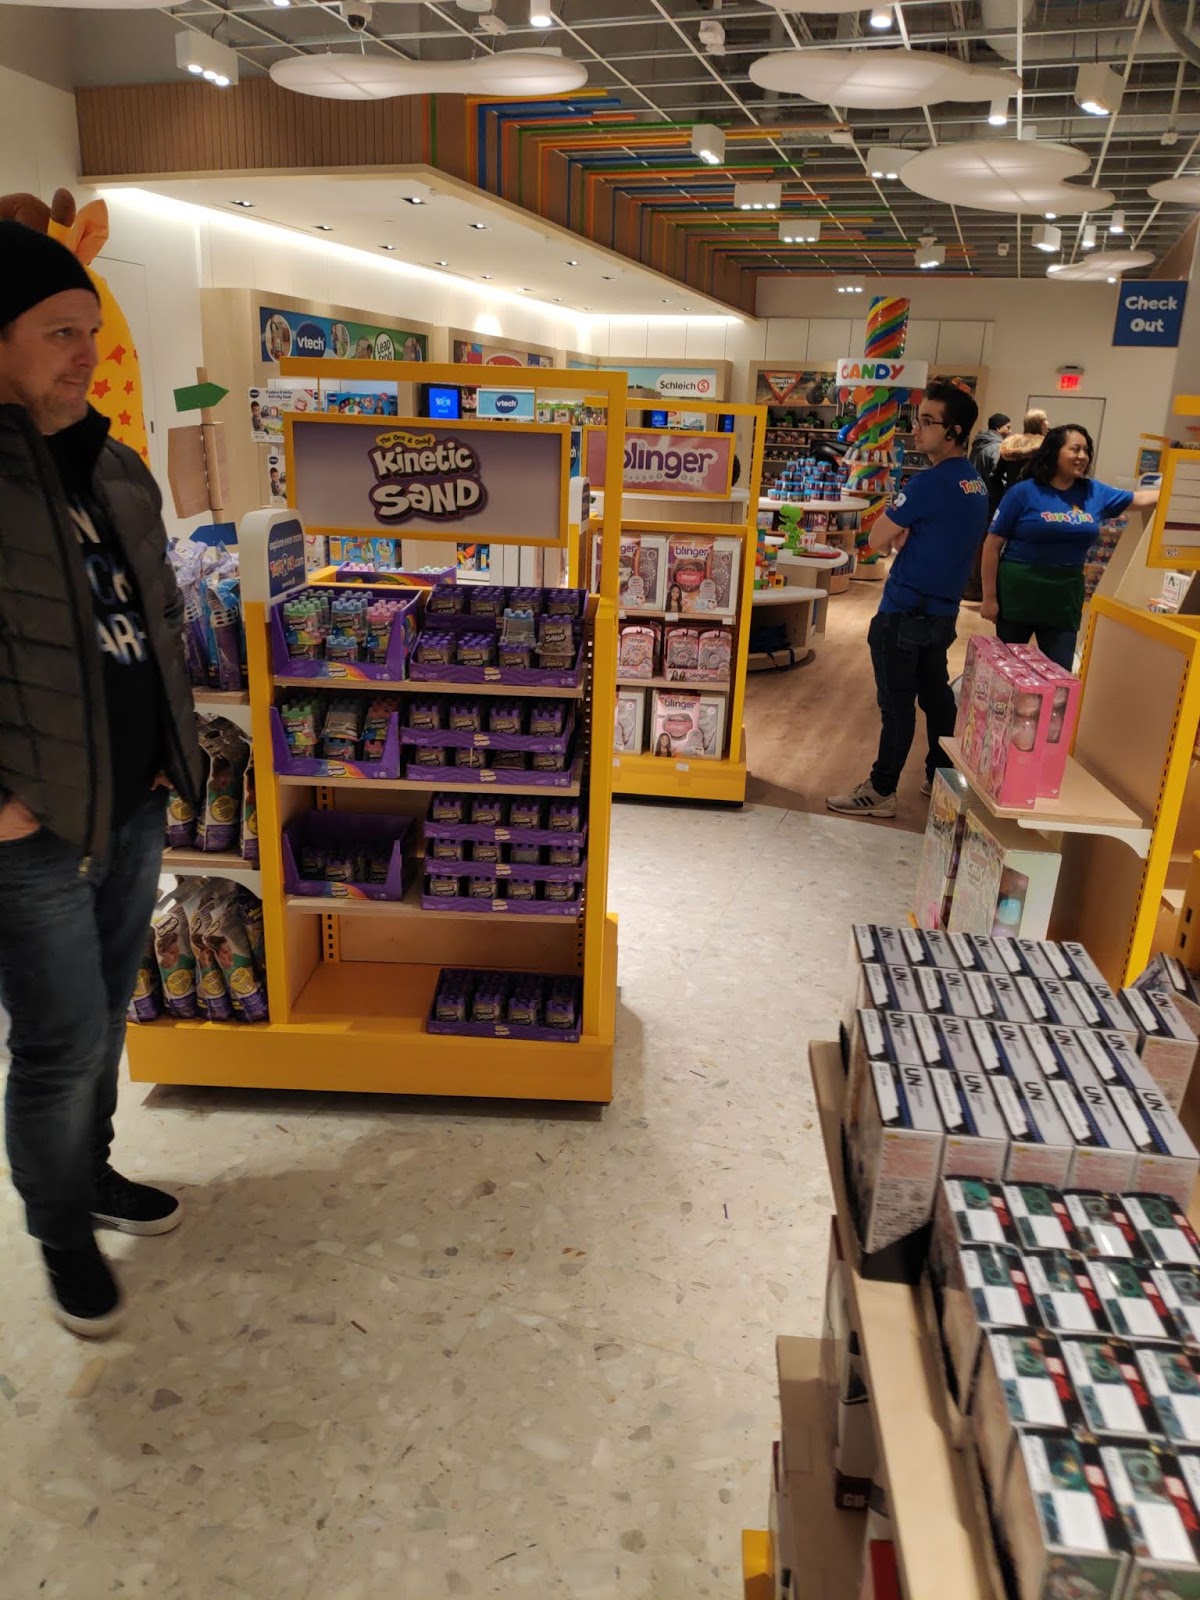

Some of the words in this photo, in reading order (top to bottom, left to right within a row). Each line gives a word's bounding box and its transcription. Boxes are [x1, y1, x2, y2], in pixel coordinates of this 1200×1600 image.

[1125, 296, 1178, 310] Check
[1130, 318, 1165, 333] Out
[297, 337, 324, 350] vtech
[376, 339, 391, 355] Leap
[841, 363, 905, 381] CANDY
[660, 380, 695, 391] Schleich
[496, 400, 517, 408] vtech
[393, 434, 406, 442] One
[372, 441, 473, 477] Kinetic
[674, 545, 709, 557] blinger
[664, 697, 696, 710] blinger
